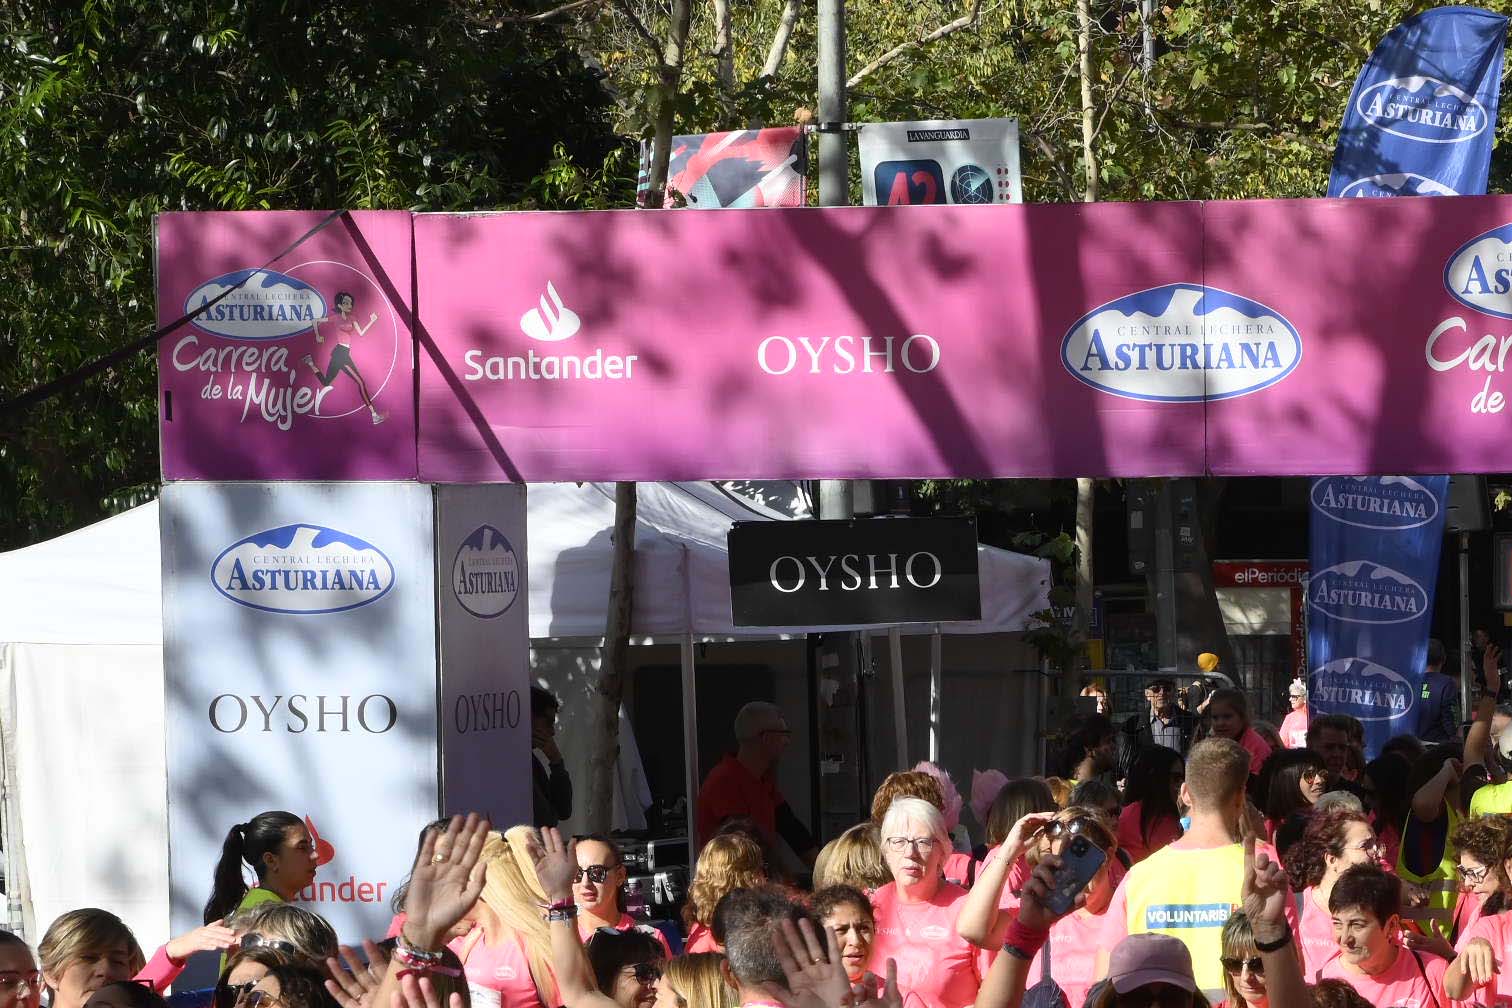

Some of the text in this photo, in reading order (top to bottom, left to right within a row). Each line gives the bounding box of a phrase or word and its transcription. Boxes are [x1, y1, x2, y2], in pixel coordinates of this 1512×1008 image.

[1366, 92, 1477, 132] ASTURIANA
[194, 294, 315, 322] ASTURIANA
[222, 292, 260, 301] ENTRAL
[1117, 323, 1275, 337] CENTRAL LECHERA
[172, 335, 290, 373] Carrera
[464, 348, 638, 381] Santander
[757, 334, 942, 376] OYSHO
[1080, 328, 1283, 372] ASTURIANA
[201, 369, 334, 431] de la Mujer
[1470, 375, 1506, 414] de
[1320, 483, 1428, 519] ASTURIANA
[226, 557, 382, 591] ASTURIANA
[253, 555, 375, 565] CENTRAL LECHERA
[458, 558, 516, 596] ASTURIANA
[769, 550, 943, 594] OYSHO
[1314, 579, 1418, 612] ASTURIANA
[454, 689, 521, 734] OYSHO
[1313, 677, 1407, 710] ASTURIANA
[208, 693, 398, 734] OYSHO
[300, 875, 388, 903] ander
[1147, 908, 1229, 924] VOLUNTARIS
